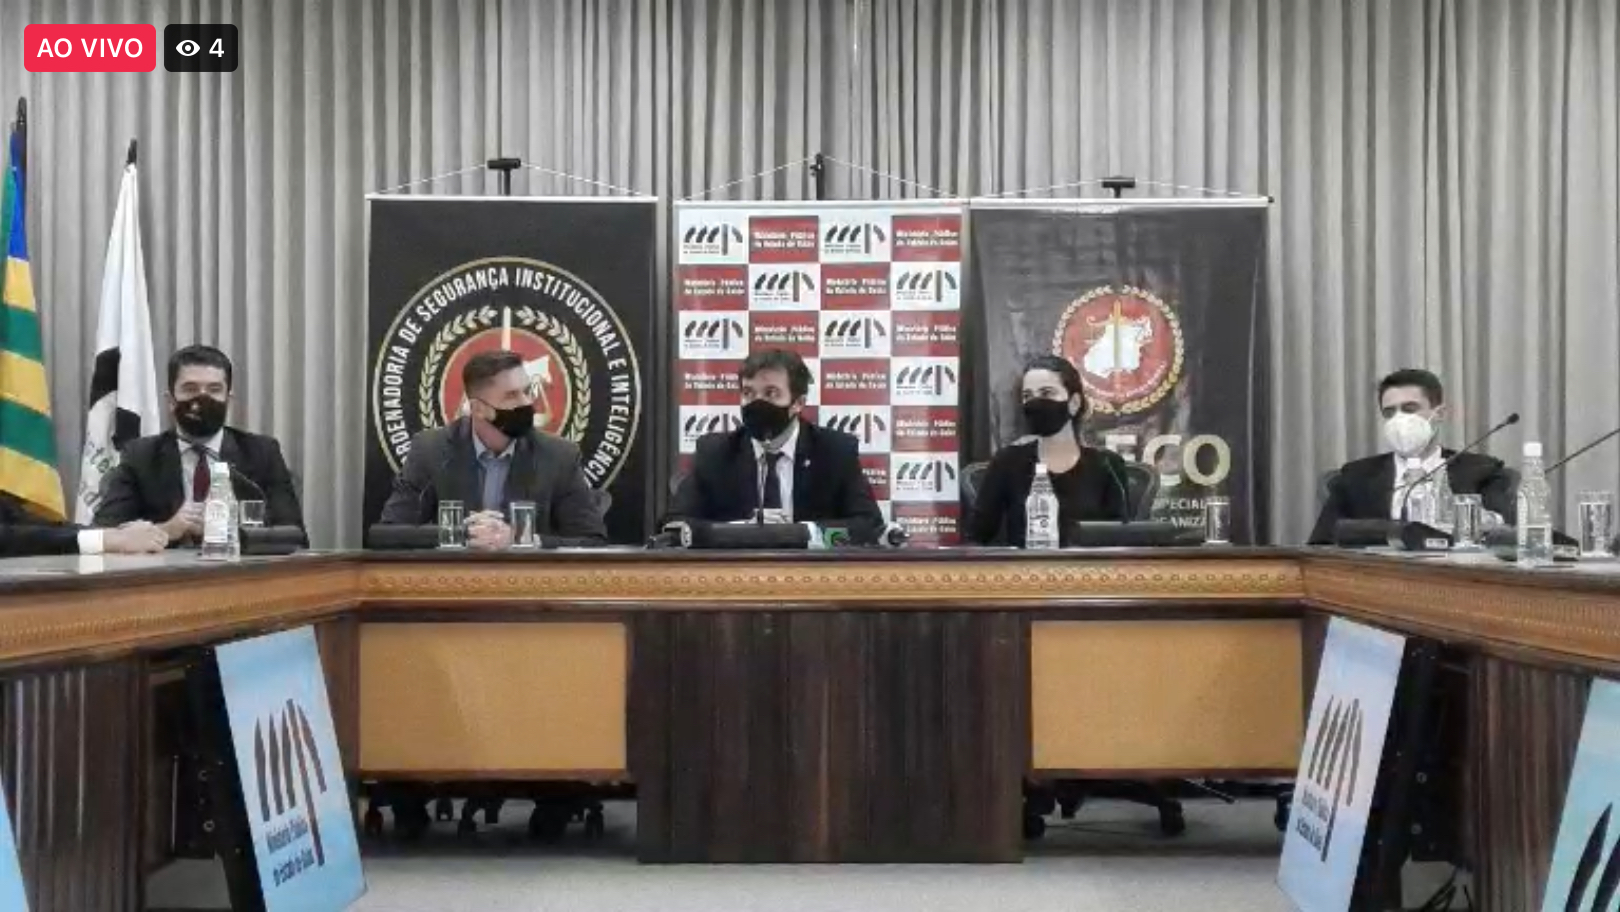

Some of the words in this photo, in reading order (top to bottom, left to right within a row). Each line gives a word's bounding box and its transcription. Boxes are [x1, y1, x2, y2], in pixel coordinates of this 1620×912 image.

[401, 318, 422, 344] DE
[416, 267, 509, 322] SEGURANÇA
[515, 267, 622, 357] INSTITUCIONAL
[608, 358, 627, 370] E
